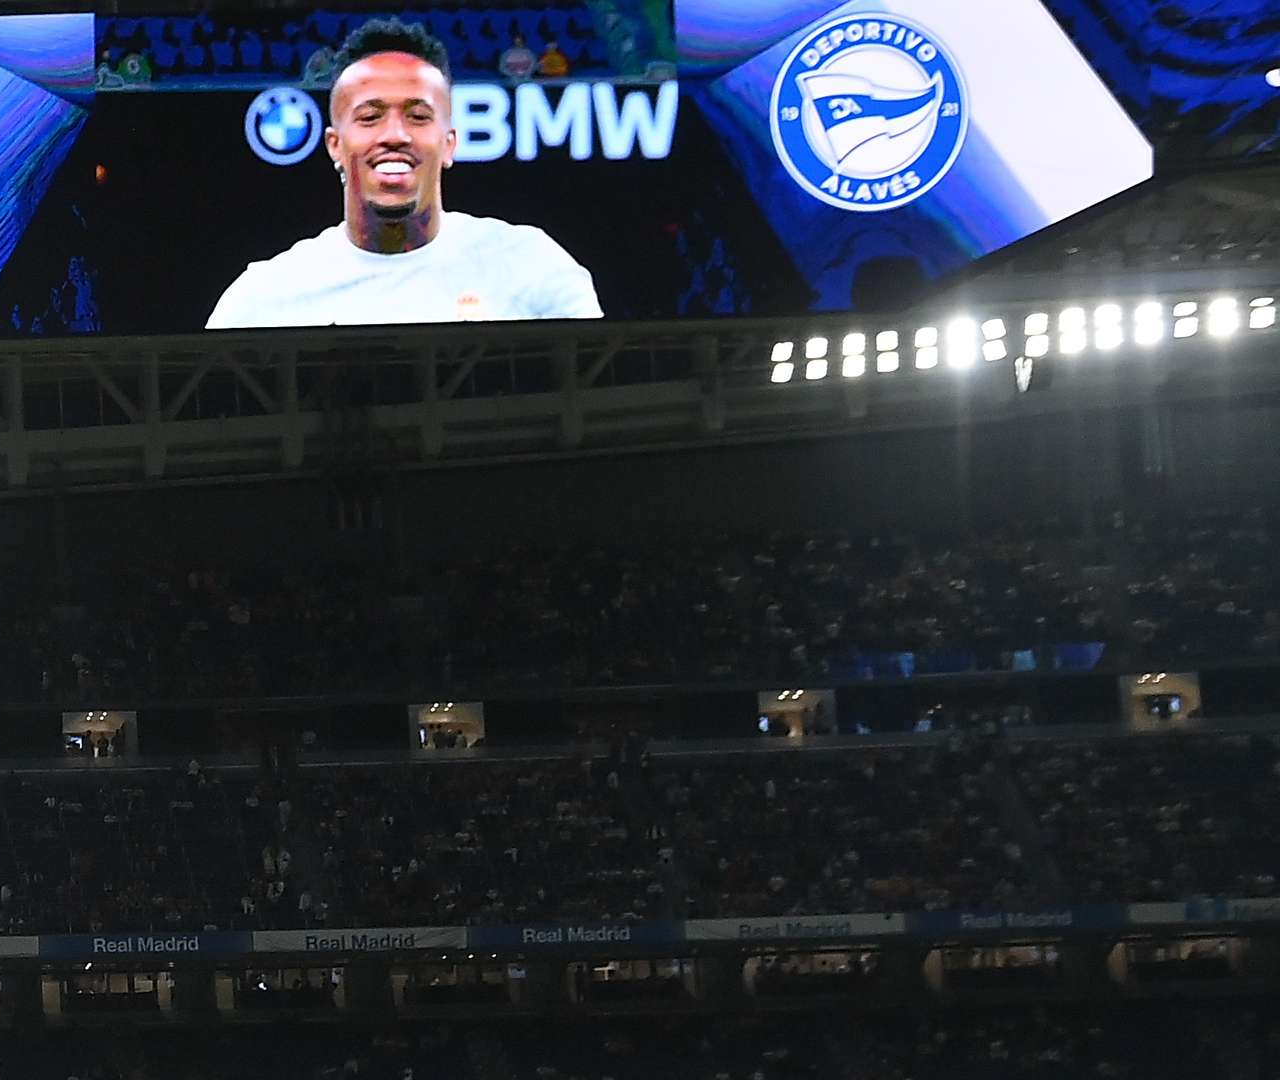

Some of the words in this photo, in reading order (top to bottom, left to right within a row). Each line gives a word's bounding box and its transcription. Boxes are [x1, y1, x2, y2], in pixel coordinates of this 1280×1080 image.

[800, 22, 937, 67] DEPORTIVO
[781, 106, 799, 121] 19
[941, 102, 959, 117] 21
[450, 80, 679, 161] BMW
[306, 935, 345, 951] Real
[351, 934, 415, 950] Madrid
[522, 927, 562, 944] Real
[568, 926, 631, 942] Madrid
[93, 937, 132, 953] Real
[138, 936, 199, 952] Madrid
